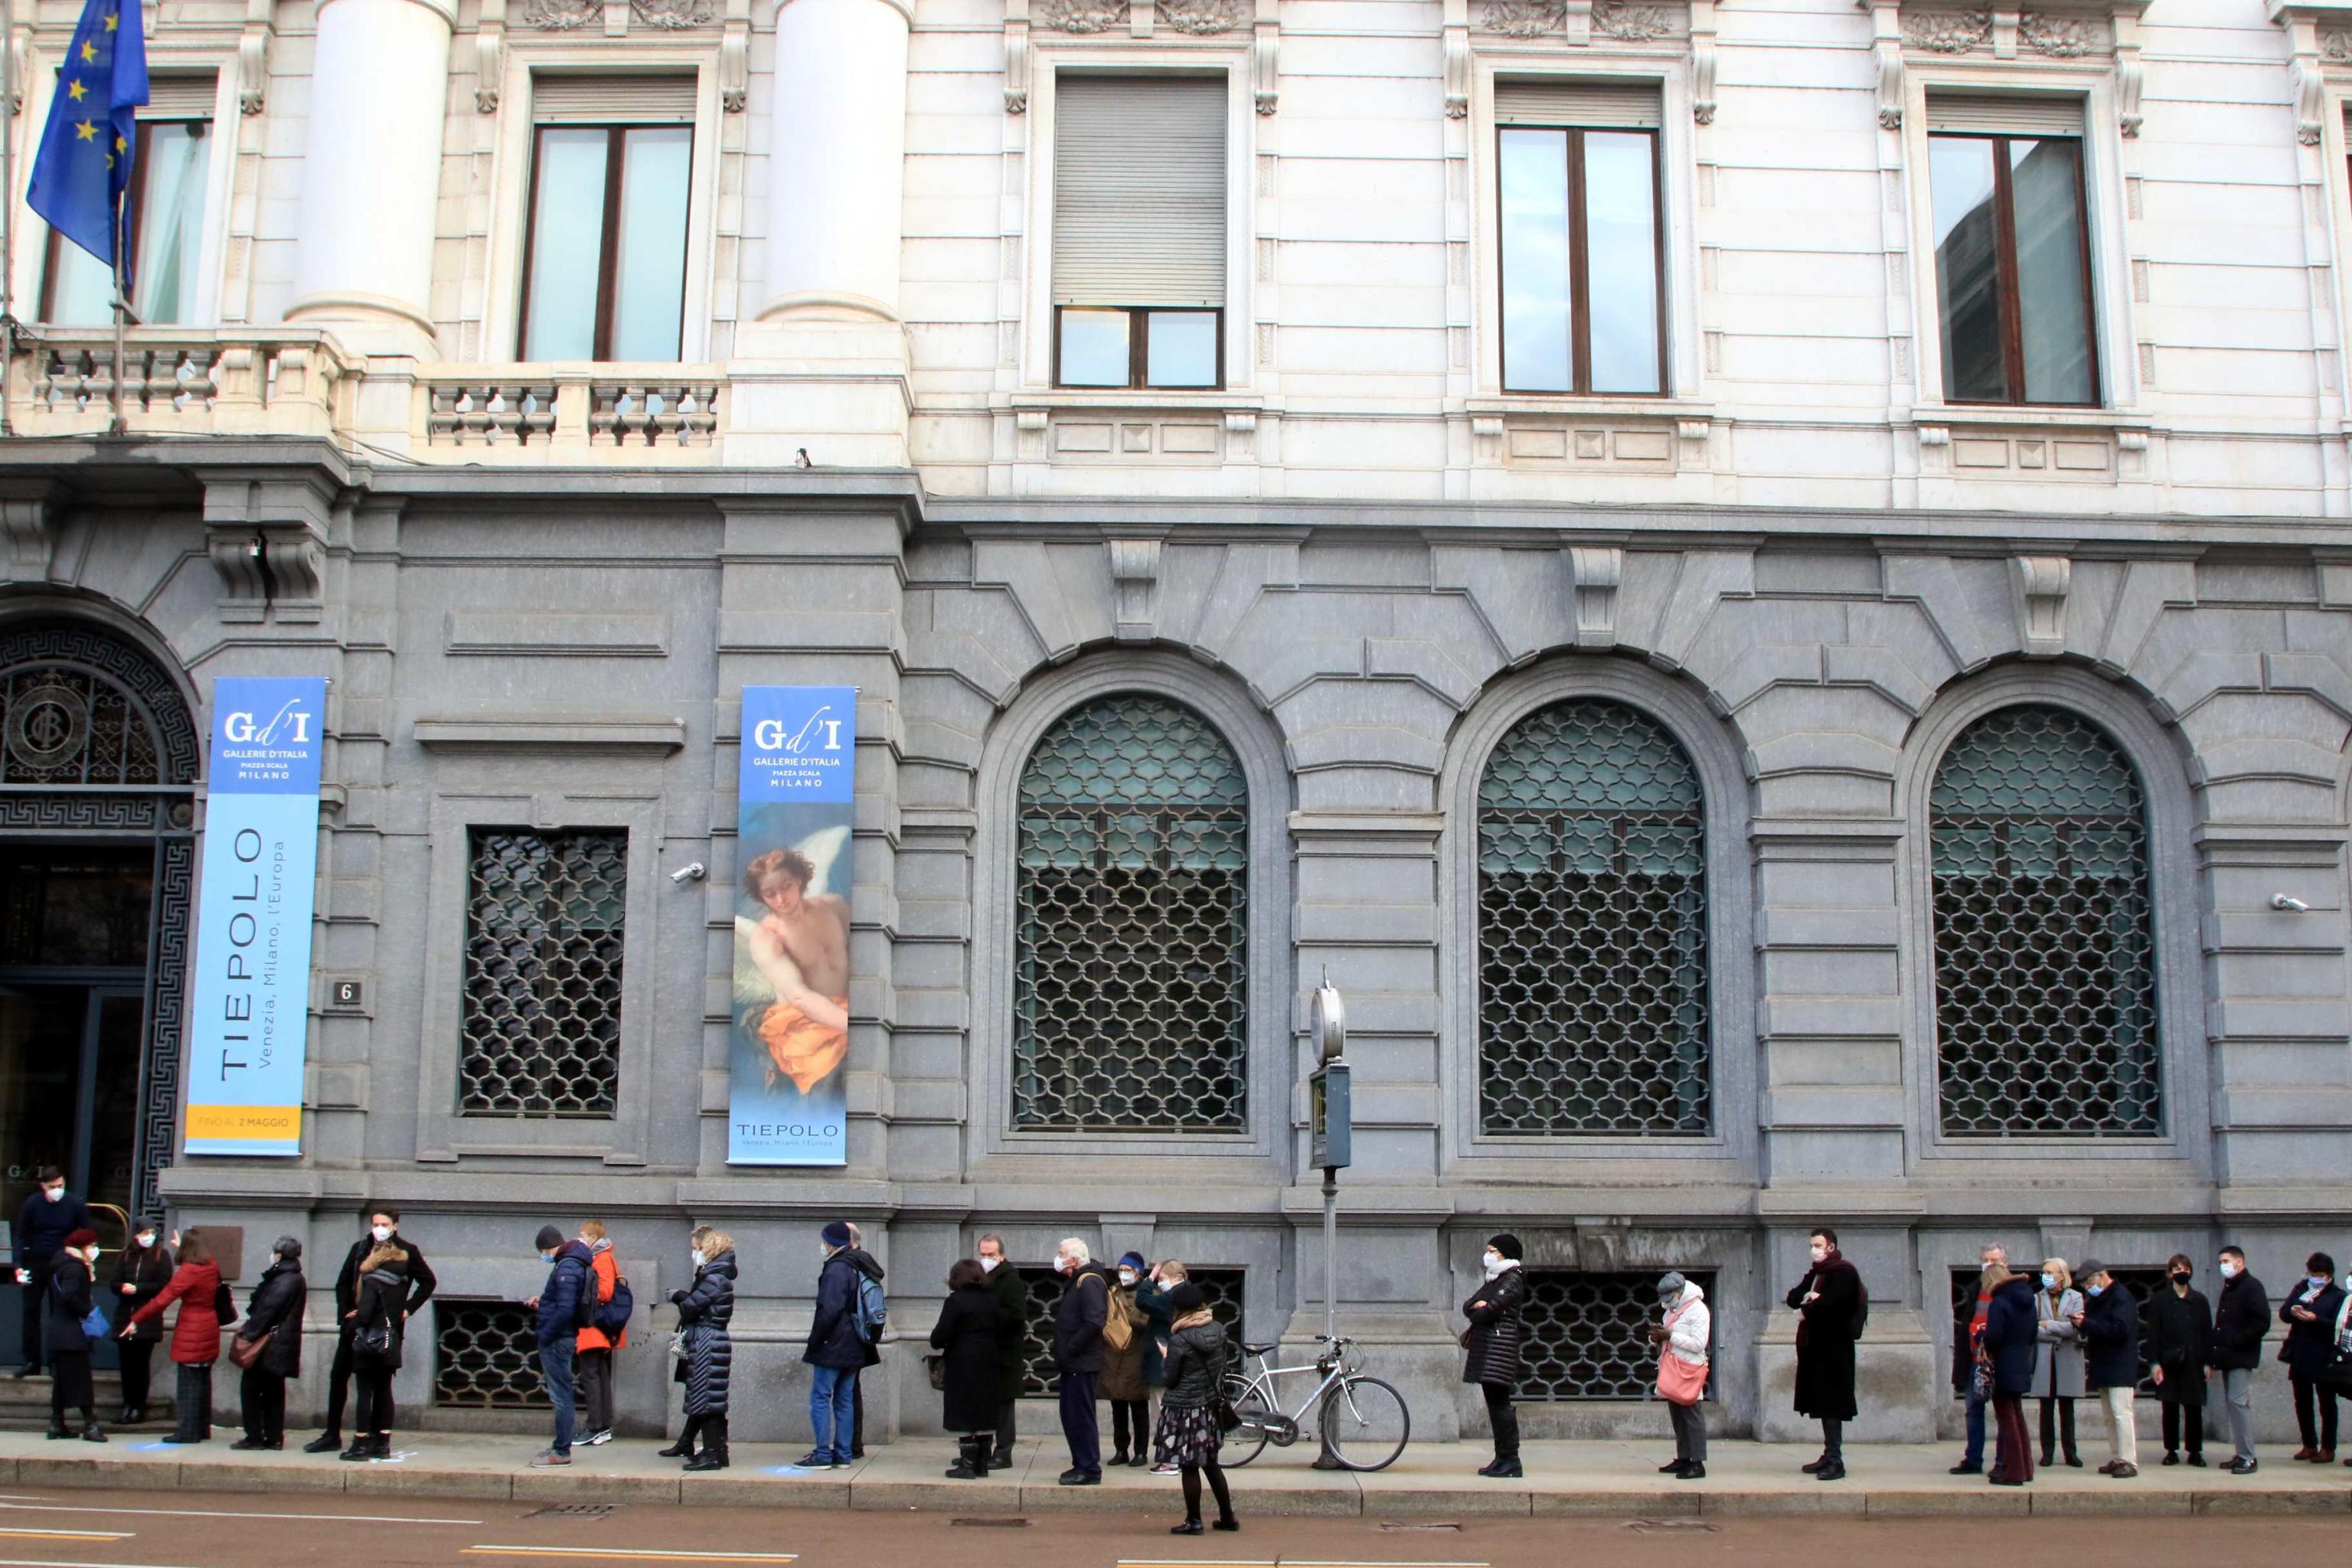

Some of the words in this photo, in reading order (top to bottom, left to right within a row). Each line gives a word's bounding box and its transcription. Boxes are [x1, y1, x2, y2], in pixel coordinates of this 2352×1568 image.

[269, 750, 308, 759] D'ITALIA
[753, 757, 799, 766] GALLERIE
[801, 757, 841, 766] D'ITALIA
[268, 841, 286, 914] l'Europa
[221, 828, 262, 1081] TIEPOLO
[263, 923, 280, 985] Milano,
[341, 985, 352, 999] 6
[259, 995, 278, 1069] Venezia,
[198, 1117, 222, 1126] FINO
[225, 1117, 235, 1126] AL
[239, 1118, 245, 1126] 2
[247, 1118, 289, 1127] MAGGIO
[737, 1124, 838, 1137] TIEPOLO
